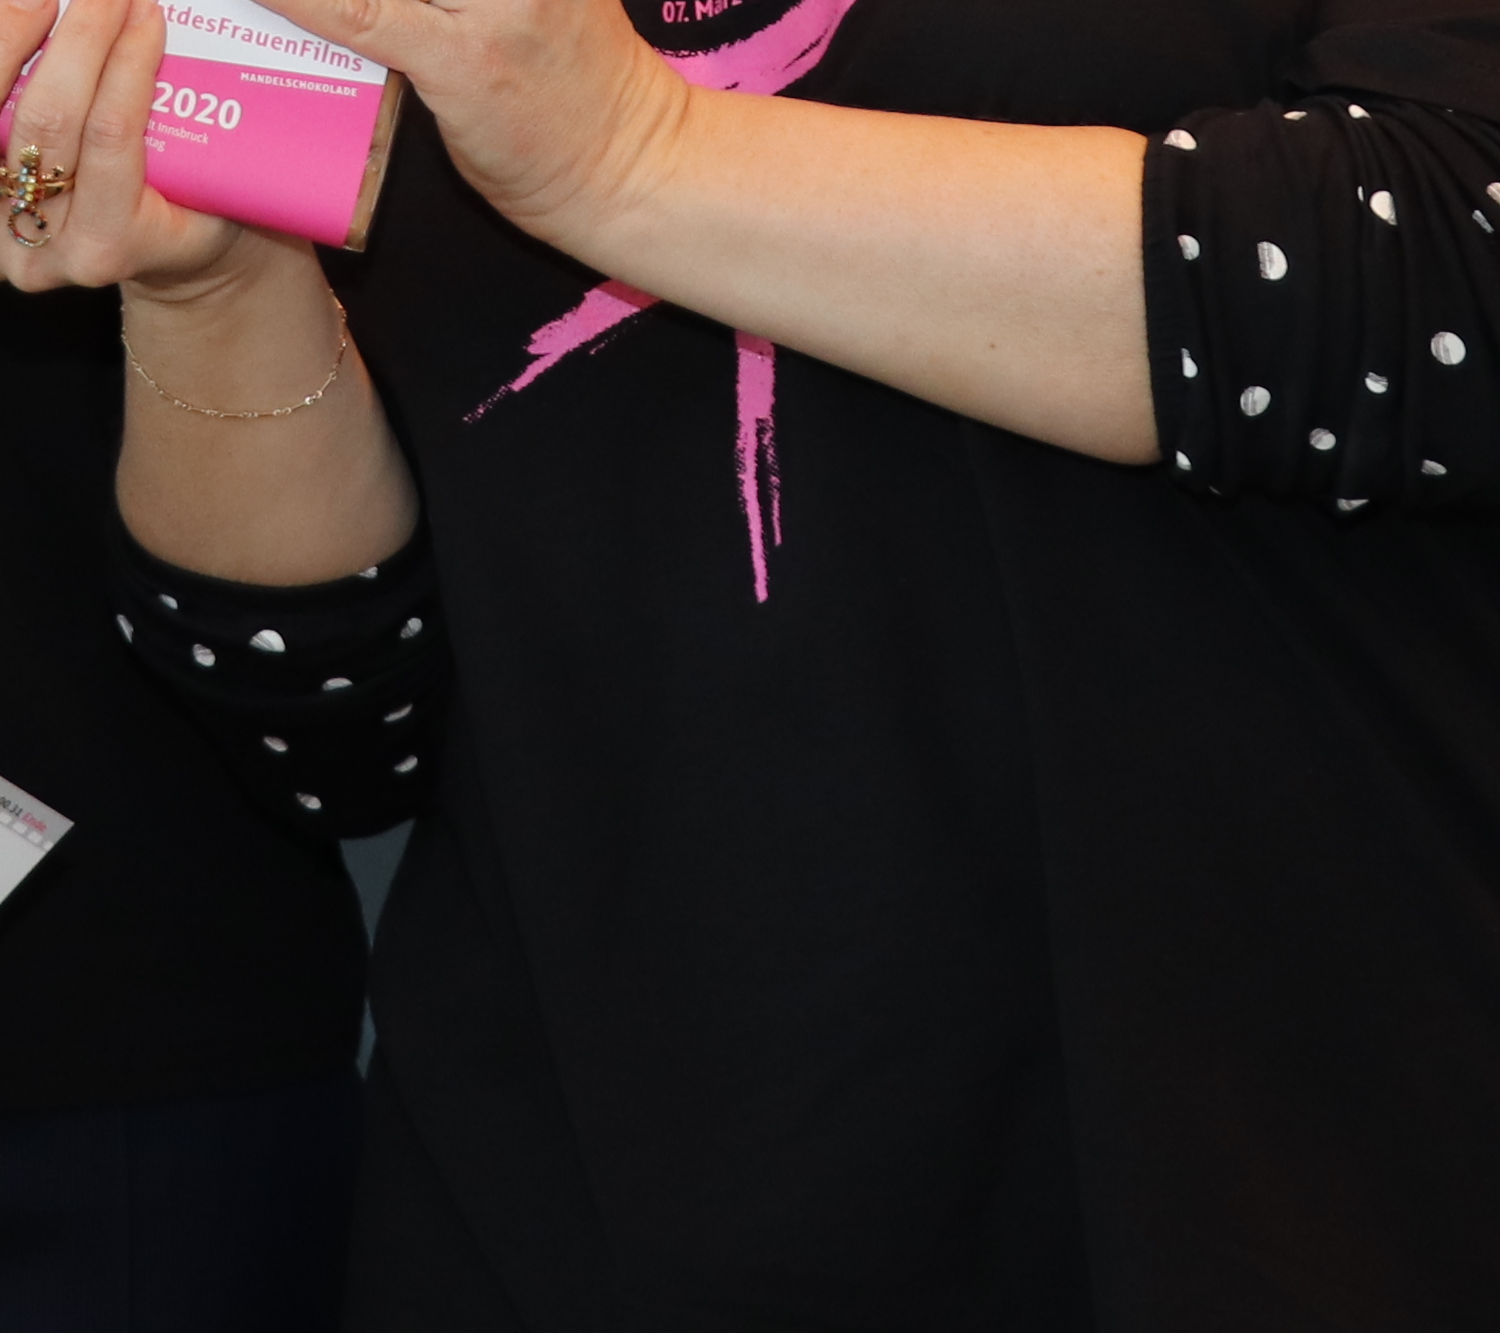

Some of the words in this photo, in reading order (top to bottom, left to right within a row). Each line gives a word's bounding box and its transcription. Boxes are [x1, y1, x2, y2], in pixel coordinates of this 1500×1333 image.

[662, 0, 690, 24] 07.
[239, 71, 359, 97] MANDELSCHOKOLADE
[151, 81, 243, 131] 2020
[157, 121, 210, 145] Innsbruck
